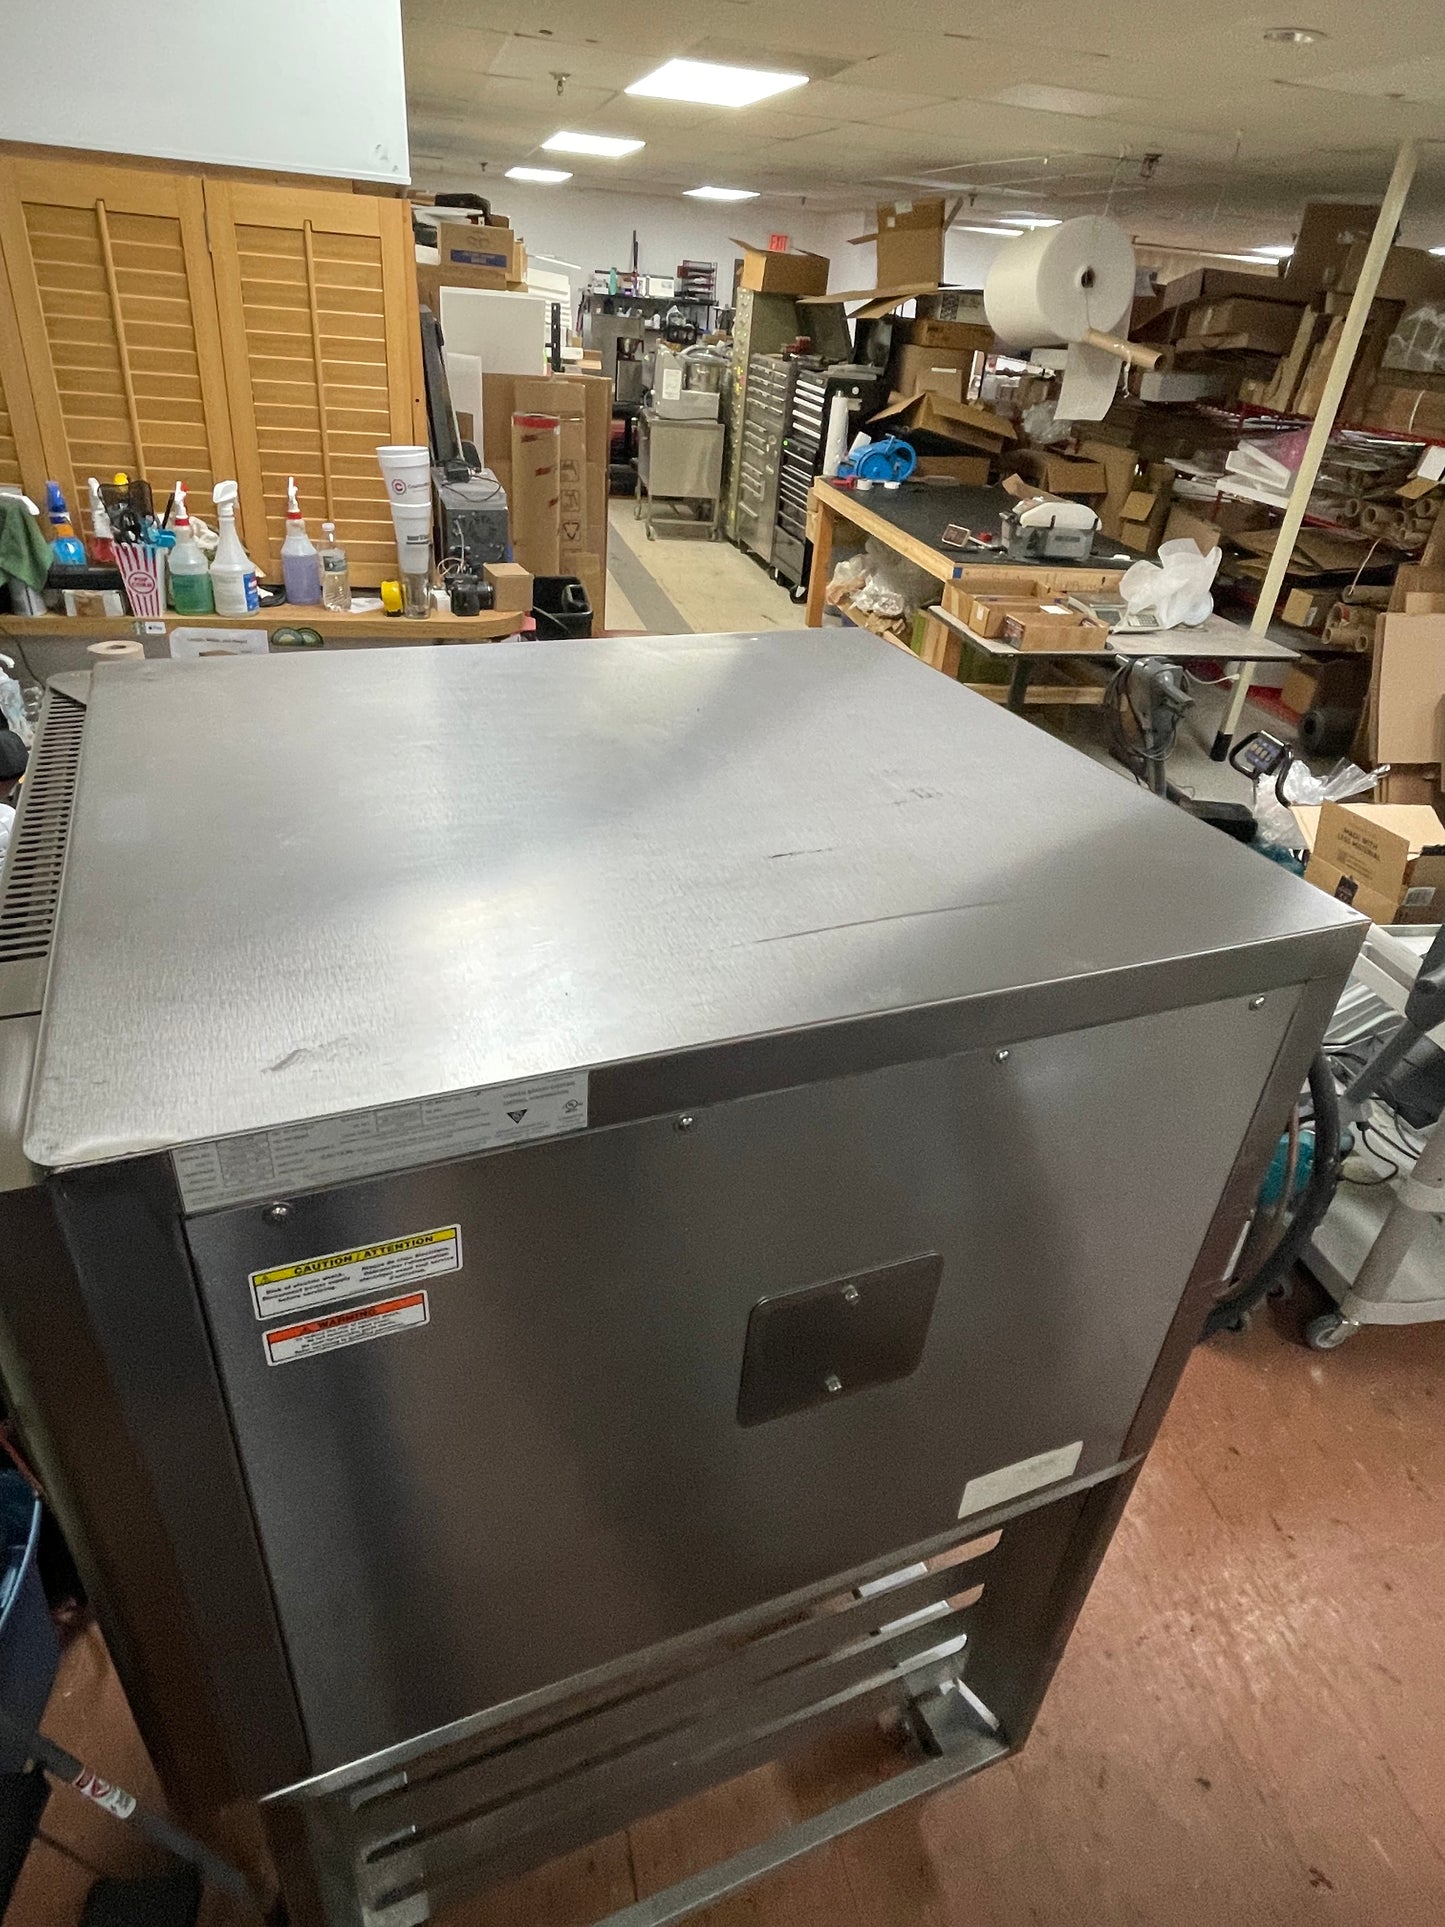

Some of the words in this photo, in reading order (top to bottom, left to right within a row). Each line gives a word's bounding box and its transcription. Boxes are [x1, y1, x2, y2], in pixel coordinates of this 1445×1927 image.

[770, 235, 788, 251] EXIT
[294, 1255, 353, 1275] CAUTION
[364, 1235, 434, 1258] ATTENTION
[319, 1309, 377, 1329] WARNING
